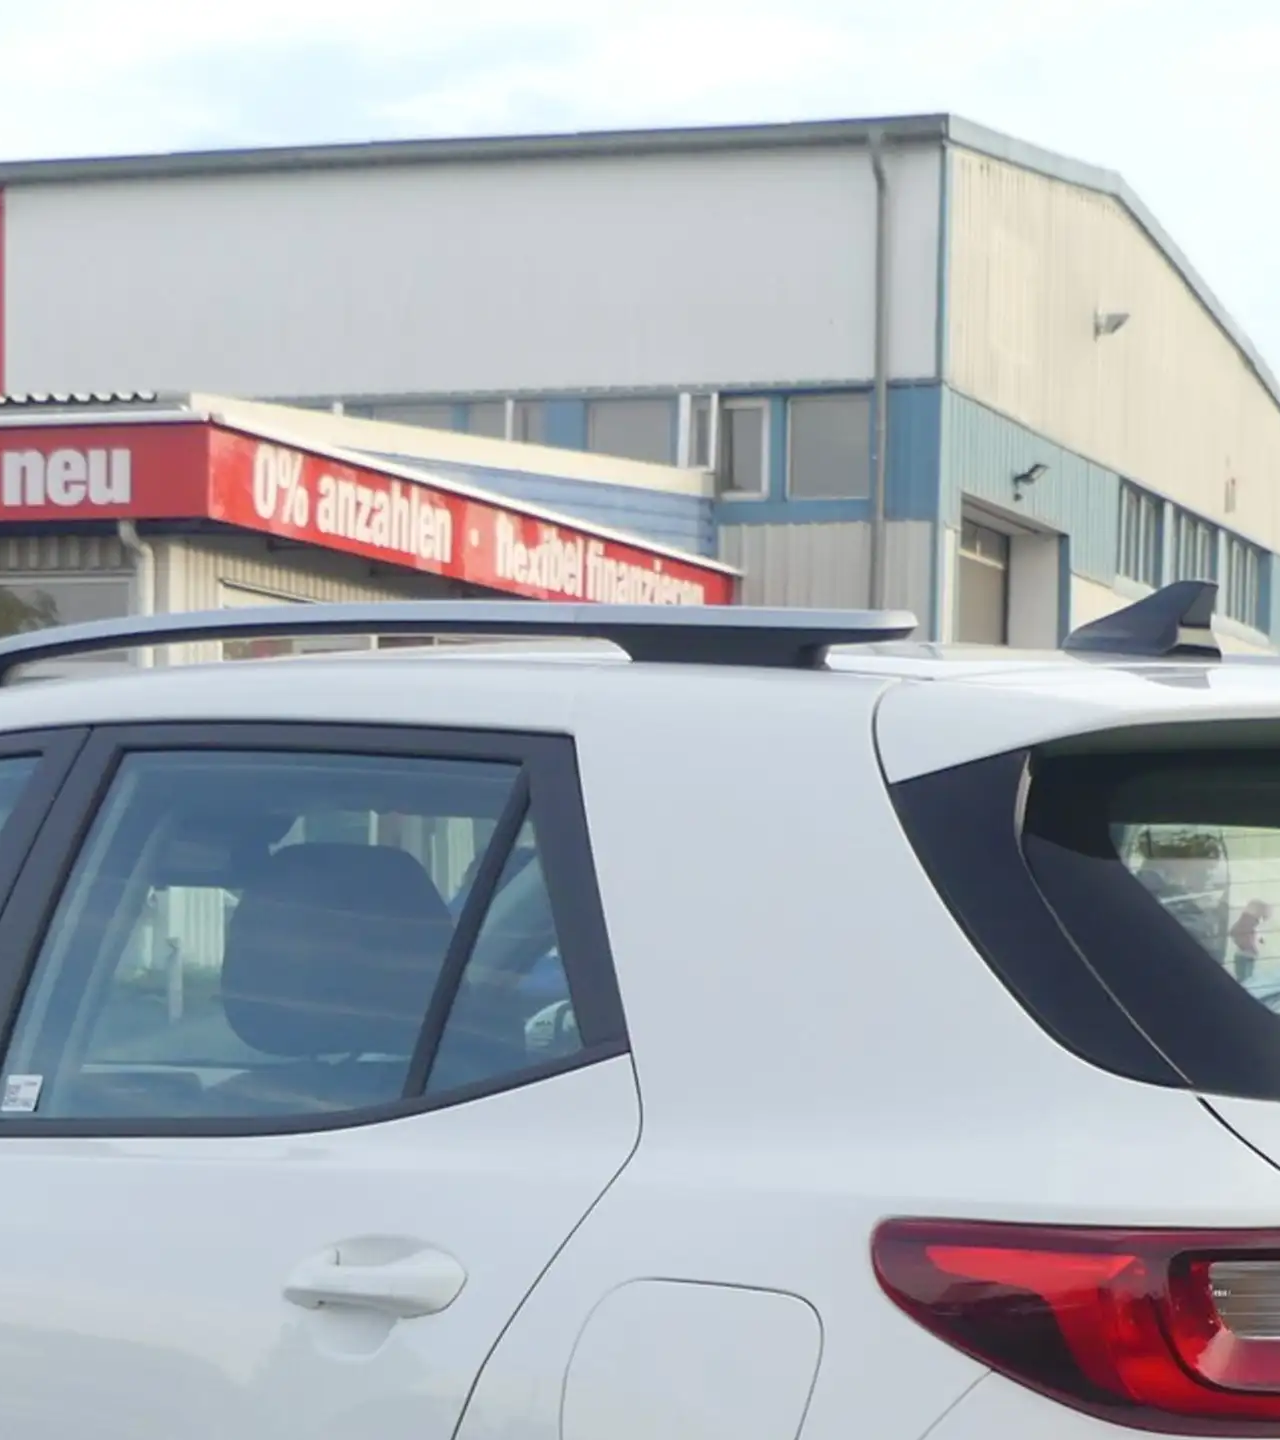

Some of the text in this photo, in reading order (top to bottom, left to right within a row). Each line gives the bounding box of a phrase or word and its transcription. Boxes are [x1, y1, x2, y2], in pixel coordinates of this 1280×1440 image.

[2, 448, 131, 507] neu
[253, 444, 309, 527] 0%
[318, 475, 452, 563] anzahlen
[495, 514, 584, 598] flexibel
